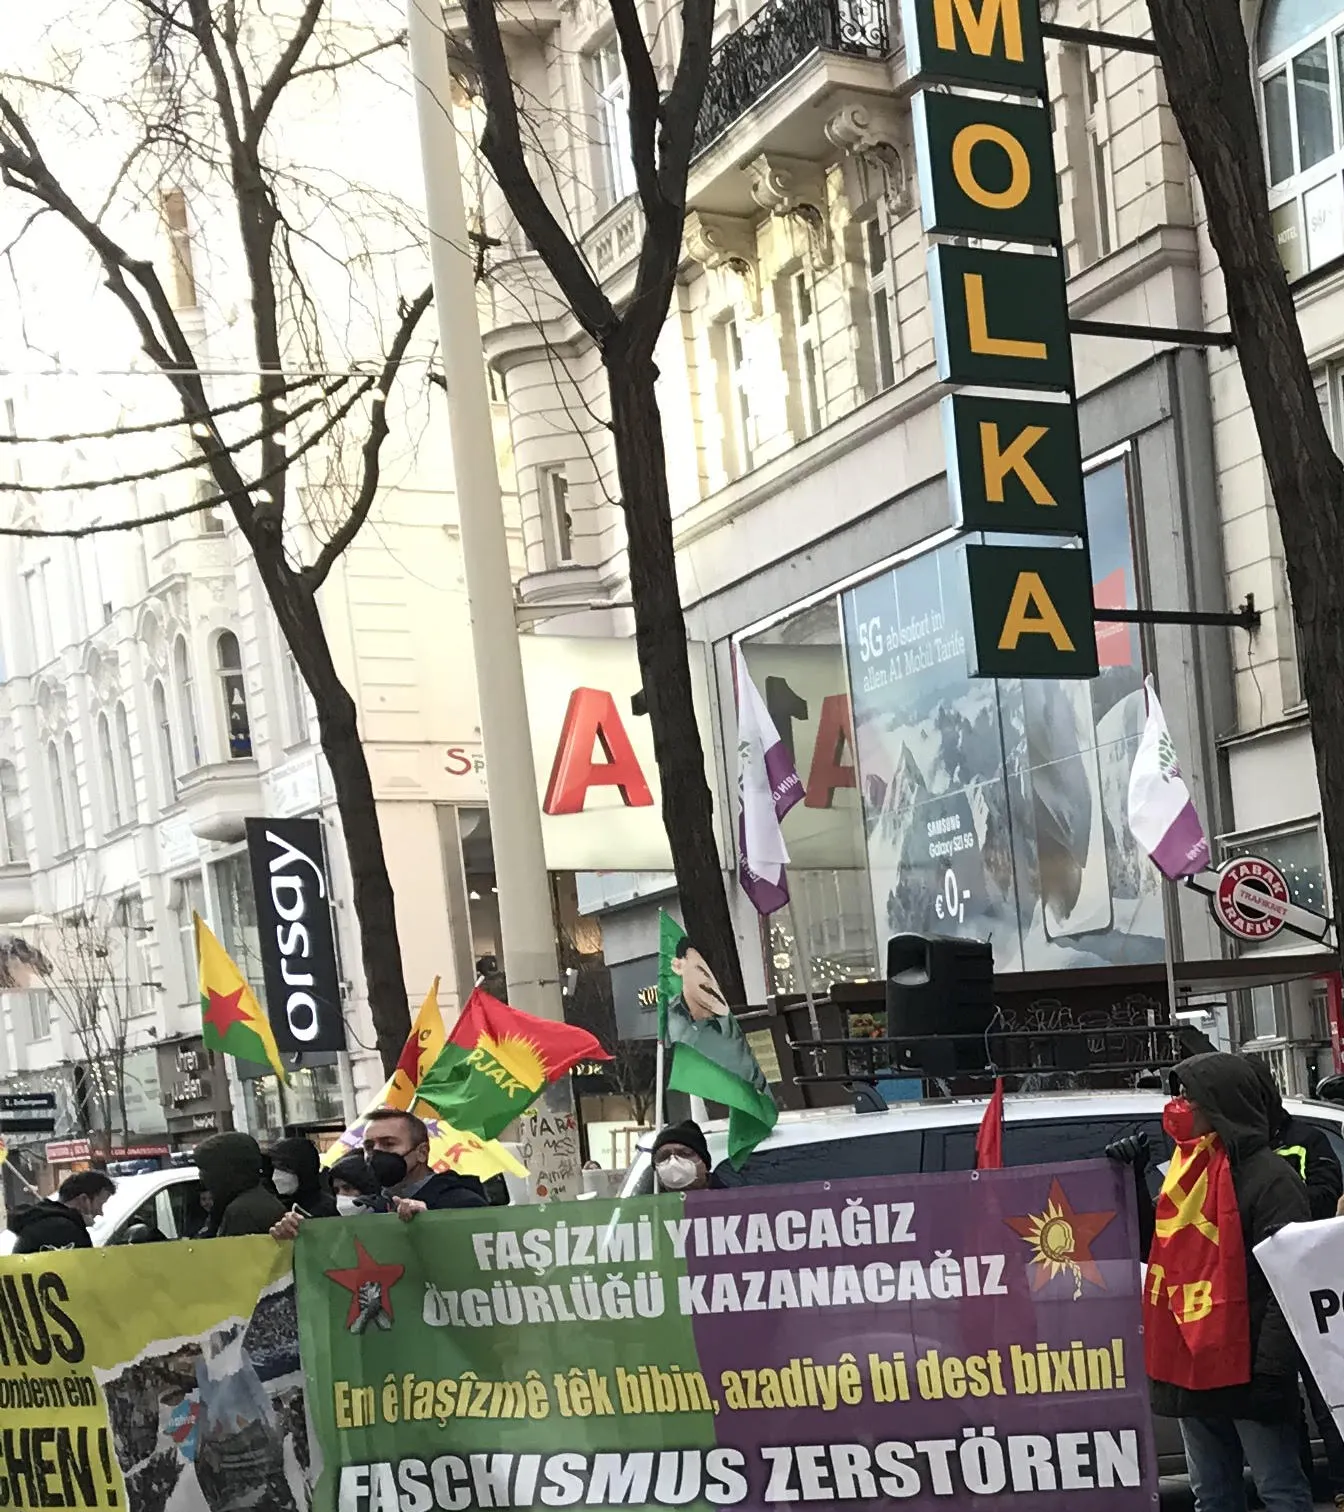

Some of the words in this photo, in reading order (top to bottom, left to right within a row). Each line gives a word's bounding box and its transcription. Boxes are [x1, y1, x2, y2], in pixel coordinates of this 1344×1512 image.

[859, 616, 884, 662] 5G
[899, 613, 931, 647] sofort
[863, 667, 888, 693] allen
[904, 646, 936, 677] Mobil
[934, 634, 965, 668] Tarife
[927, 814, 960, 837] SAMSUNG
[928, 840, 953, 858] Galaxy
[1228, 863, 1285, 894] TABAK
[265, 830, 327, 1042] orsay
[1221, 896, 1276, 934] TRAFIK
[466, 1049, 526, 1099] PJAK
[472, 1215, 653, 1275] FAŞİZMİ
[664, 1197, 916, 1259] YIKACAĞIZ
[423, 1271, 664, 1328] ÖZGÜRLÜĞÜ
[677, 1249, 1009, 1316] KAZANACAĞIZ
[0, 1372, 64, 1409] ondern
[63, 1369, 97, 1406] ein
[334, 1381, 376, 1429] Em
[555, 1372, 614, 1417] têk
[622, 1363, 721, 1416] bibin,
[721, 1355, 863, 1411] azadiyê
[869, 1352, 910, 1403] bi
[916, 1349, 1006, 1400] dest
[1010, 1338, 1127, 1395] bixin!
[0, 1426, 119, 1508] HEN!
[761, 1426, 1141, 1502] ZERSTÖREN
